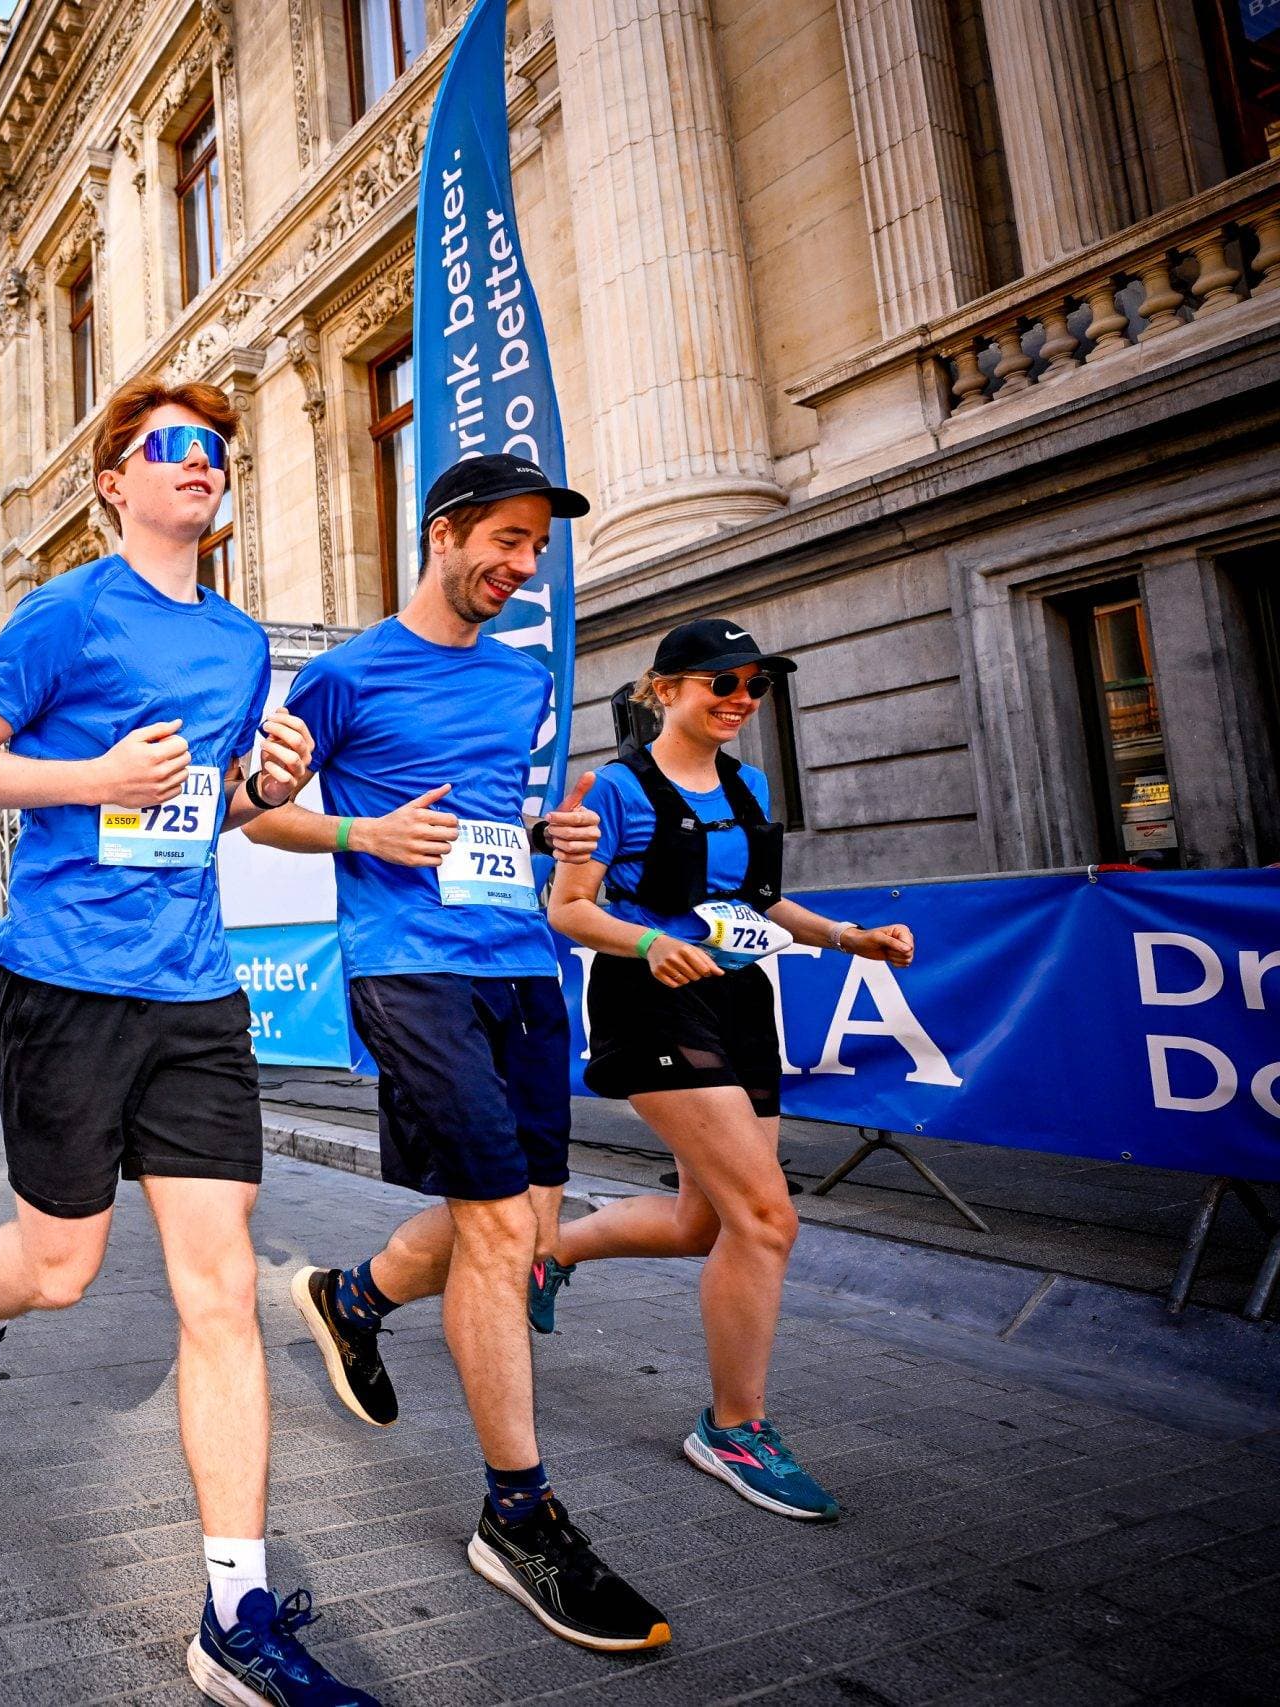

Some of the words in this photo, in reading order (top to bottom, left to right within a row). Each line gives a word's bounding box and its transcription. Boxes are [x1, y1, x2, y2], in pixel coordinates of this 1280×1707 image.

[440, 148, 476, 338] better.
[141, 804, 199, 833] 725
[472, 825, 522, 850] BRITA
[154, 850, 185, 858] BRUSSELS
[470, 852, 516, 878] 723
[732, 905, 770, 923] BRI
[733, 927, 769, 950] 724
